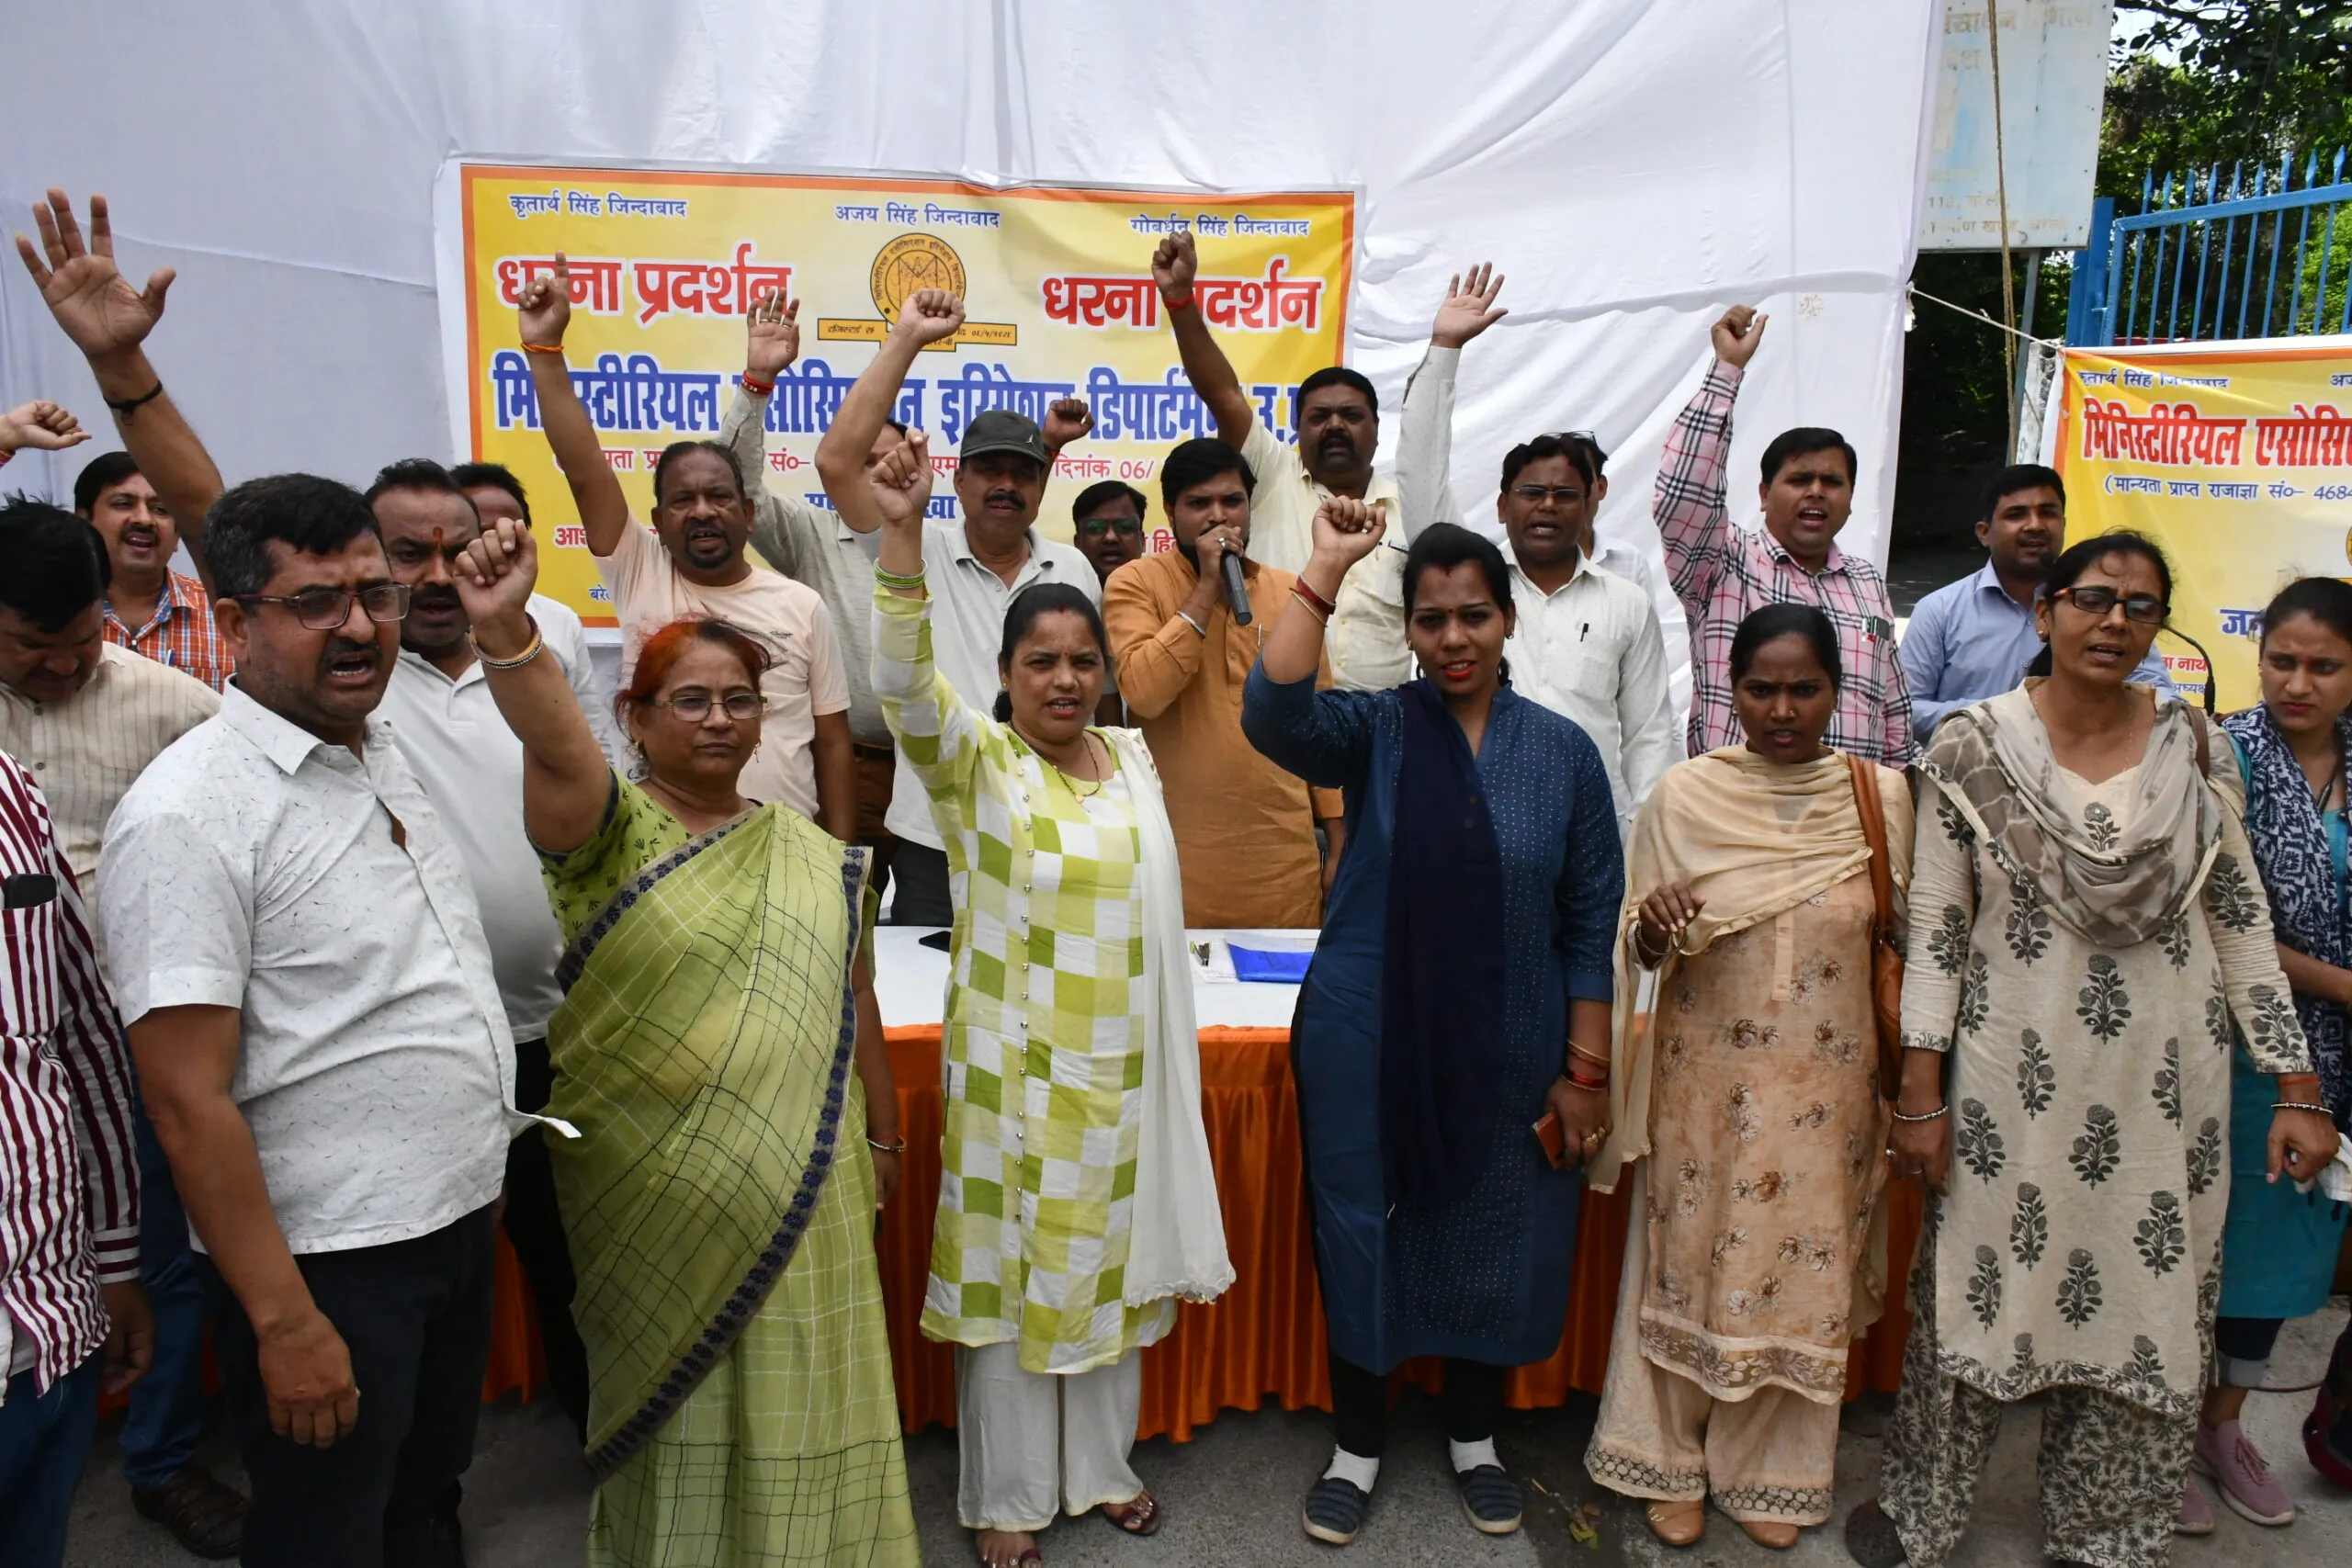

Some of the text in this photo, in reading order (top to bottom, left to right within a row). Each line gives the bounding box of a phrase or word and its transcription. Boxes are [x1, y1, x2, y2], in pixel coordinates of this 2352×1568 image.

[510, 190, 687, 218] कृतार्थ सिंह जिन्दाबाद
[835, 202, 1001, 228] अजय सिंह जिन्दाबाद
[1196, 215, 1228, 236] सिंह
[1234, 215, 1309, 236] जिन्दाबाद
[498, 243, 793, 324] धना प्रदर्शन
[1043, 277, 1158, 327] धरना
[2124, 369, 2154, 388] सिंह
[2084, 398, 2247, 466] मिनिस्टीरियल
[1054, 454, 1111, 479] दिनांक
[1119, 460, 1155, 479] 06/
[2168, 481, 2200, 497] प्राप्त
[2208, 483, 2259, 501] राजाज्ञा
